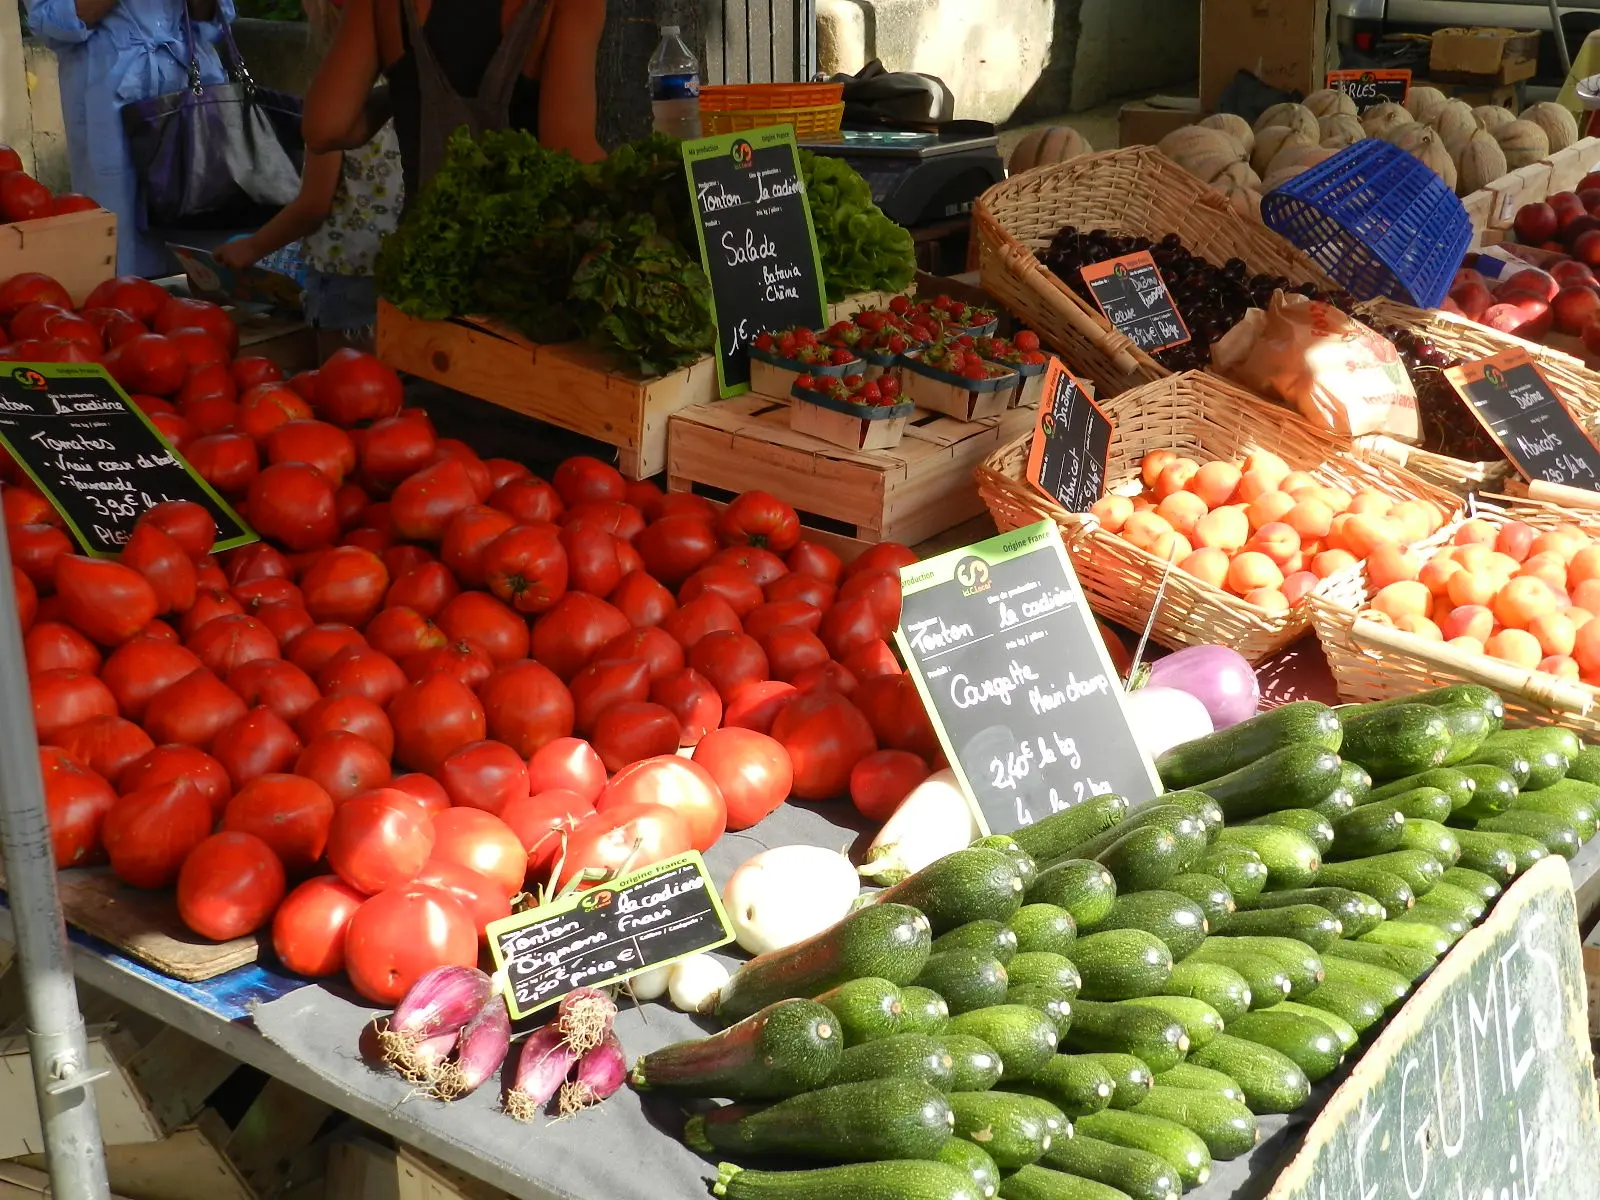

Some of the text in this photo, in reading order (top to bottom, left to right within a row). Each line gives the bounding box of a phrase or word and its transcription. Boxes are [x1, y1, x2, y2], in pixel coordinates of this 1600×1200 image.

[698, 184, 742, 212] Tonton
[721, 229, 777, 266] Salade
[30, 430, 116, 451] Tomates
[1516, 428, 1562, 460] Abricots
[1058, 447, 1081, 512] Abricot
[1002, 531, 1051, 553] Origine France
[911, 616, 974, 654] Tonton
[619, 870, 653, 888] Origine
[656, 858, 688, 873] France
[501, 921, 580, 959] Tonton
